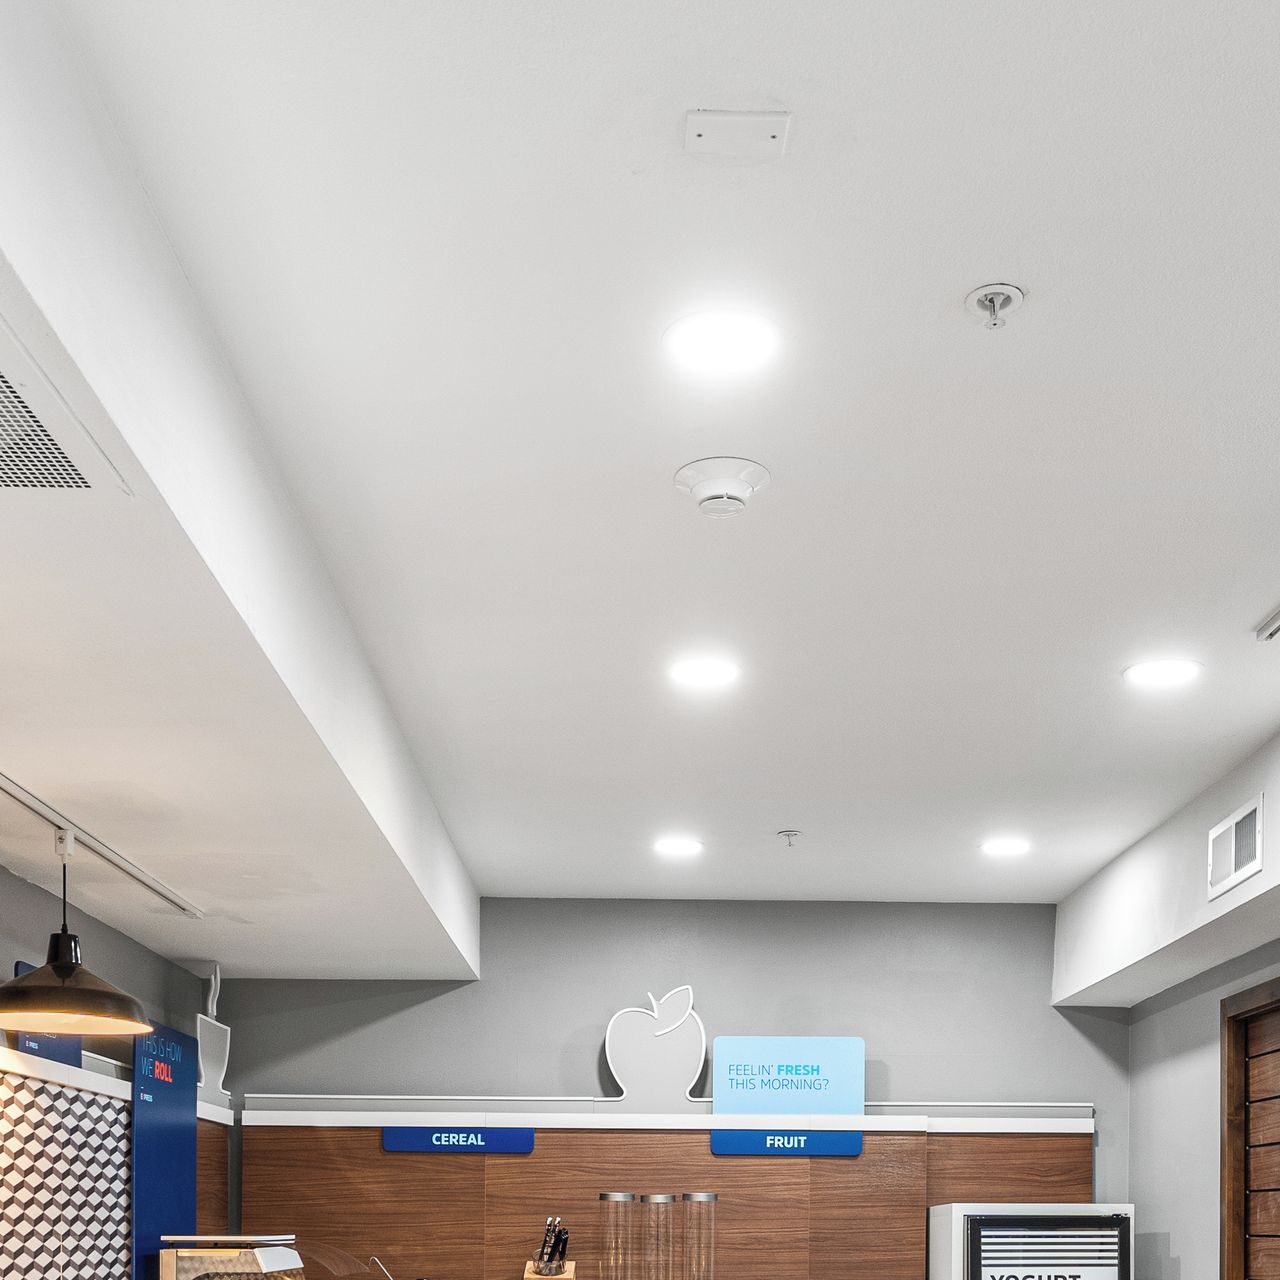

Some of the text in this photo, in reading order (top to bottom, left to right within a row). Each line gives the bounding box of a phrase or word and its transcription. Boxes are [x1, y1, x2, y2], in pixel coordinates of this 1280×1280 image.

[166, 1040, 183, 1063] HOW
[141, 1056, 173, 1083] WE ROLL
[728, 1064, 820, 1076] FEELIN' FRESH
[728, 1079, 830, 1090] THIS MORNING?
[431, 1133, 486, 1147] CEREAL
[766, 1136, 807, 1148] FRUIT
